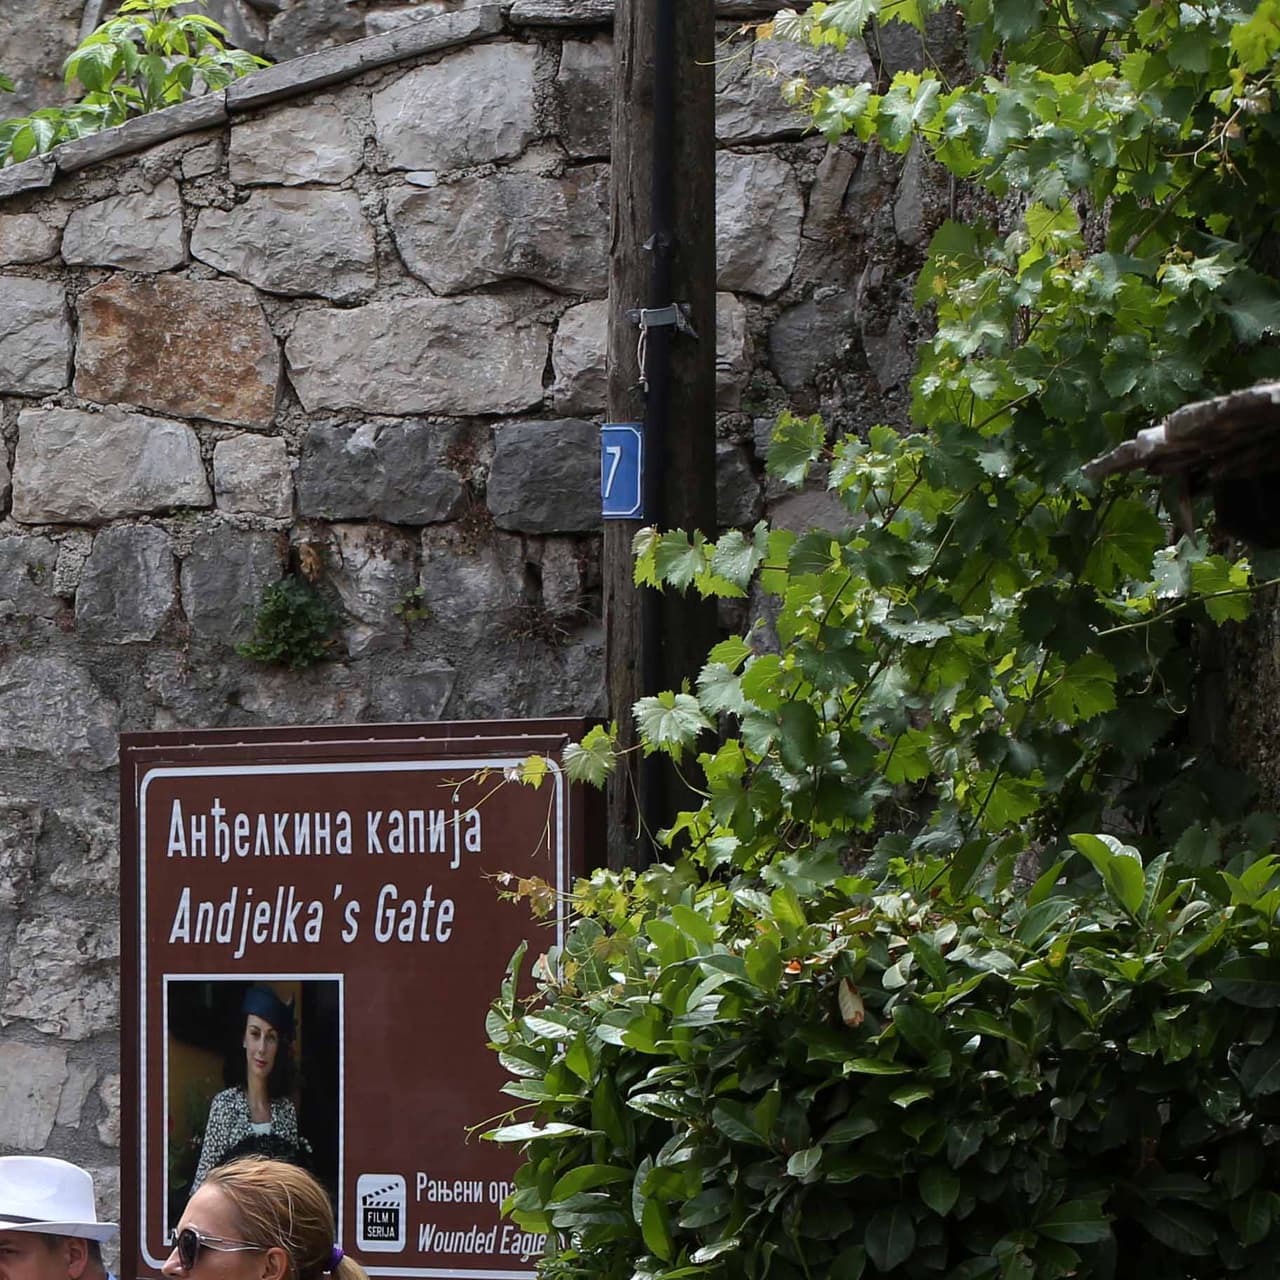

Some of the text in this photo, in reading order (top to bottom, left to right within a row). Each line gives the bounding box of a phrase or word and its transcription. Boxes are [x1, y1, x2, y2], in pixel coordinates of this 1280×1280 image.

[605, 446, 621, 498] 7
[167, 794, 482, 869] Анђелкина капија
[169, 884, 455, 959] Andjelka's Gate
[416, 1172, 518, 1212] Рањени ора
[367, 1211, 389, 1224] FILM
[367, 1225, 395, 1238] SERIJA
[418, 1223, 497, 1254] Wounded
